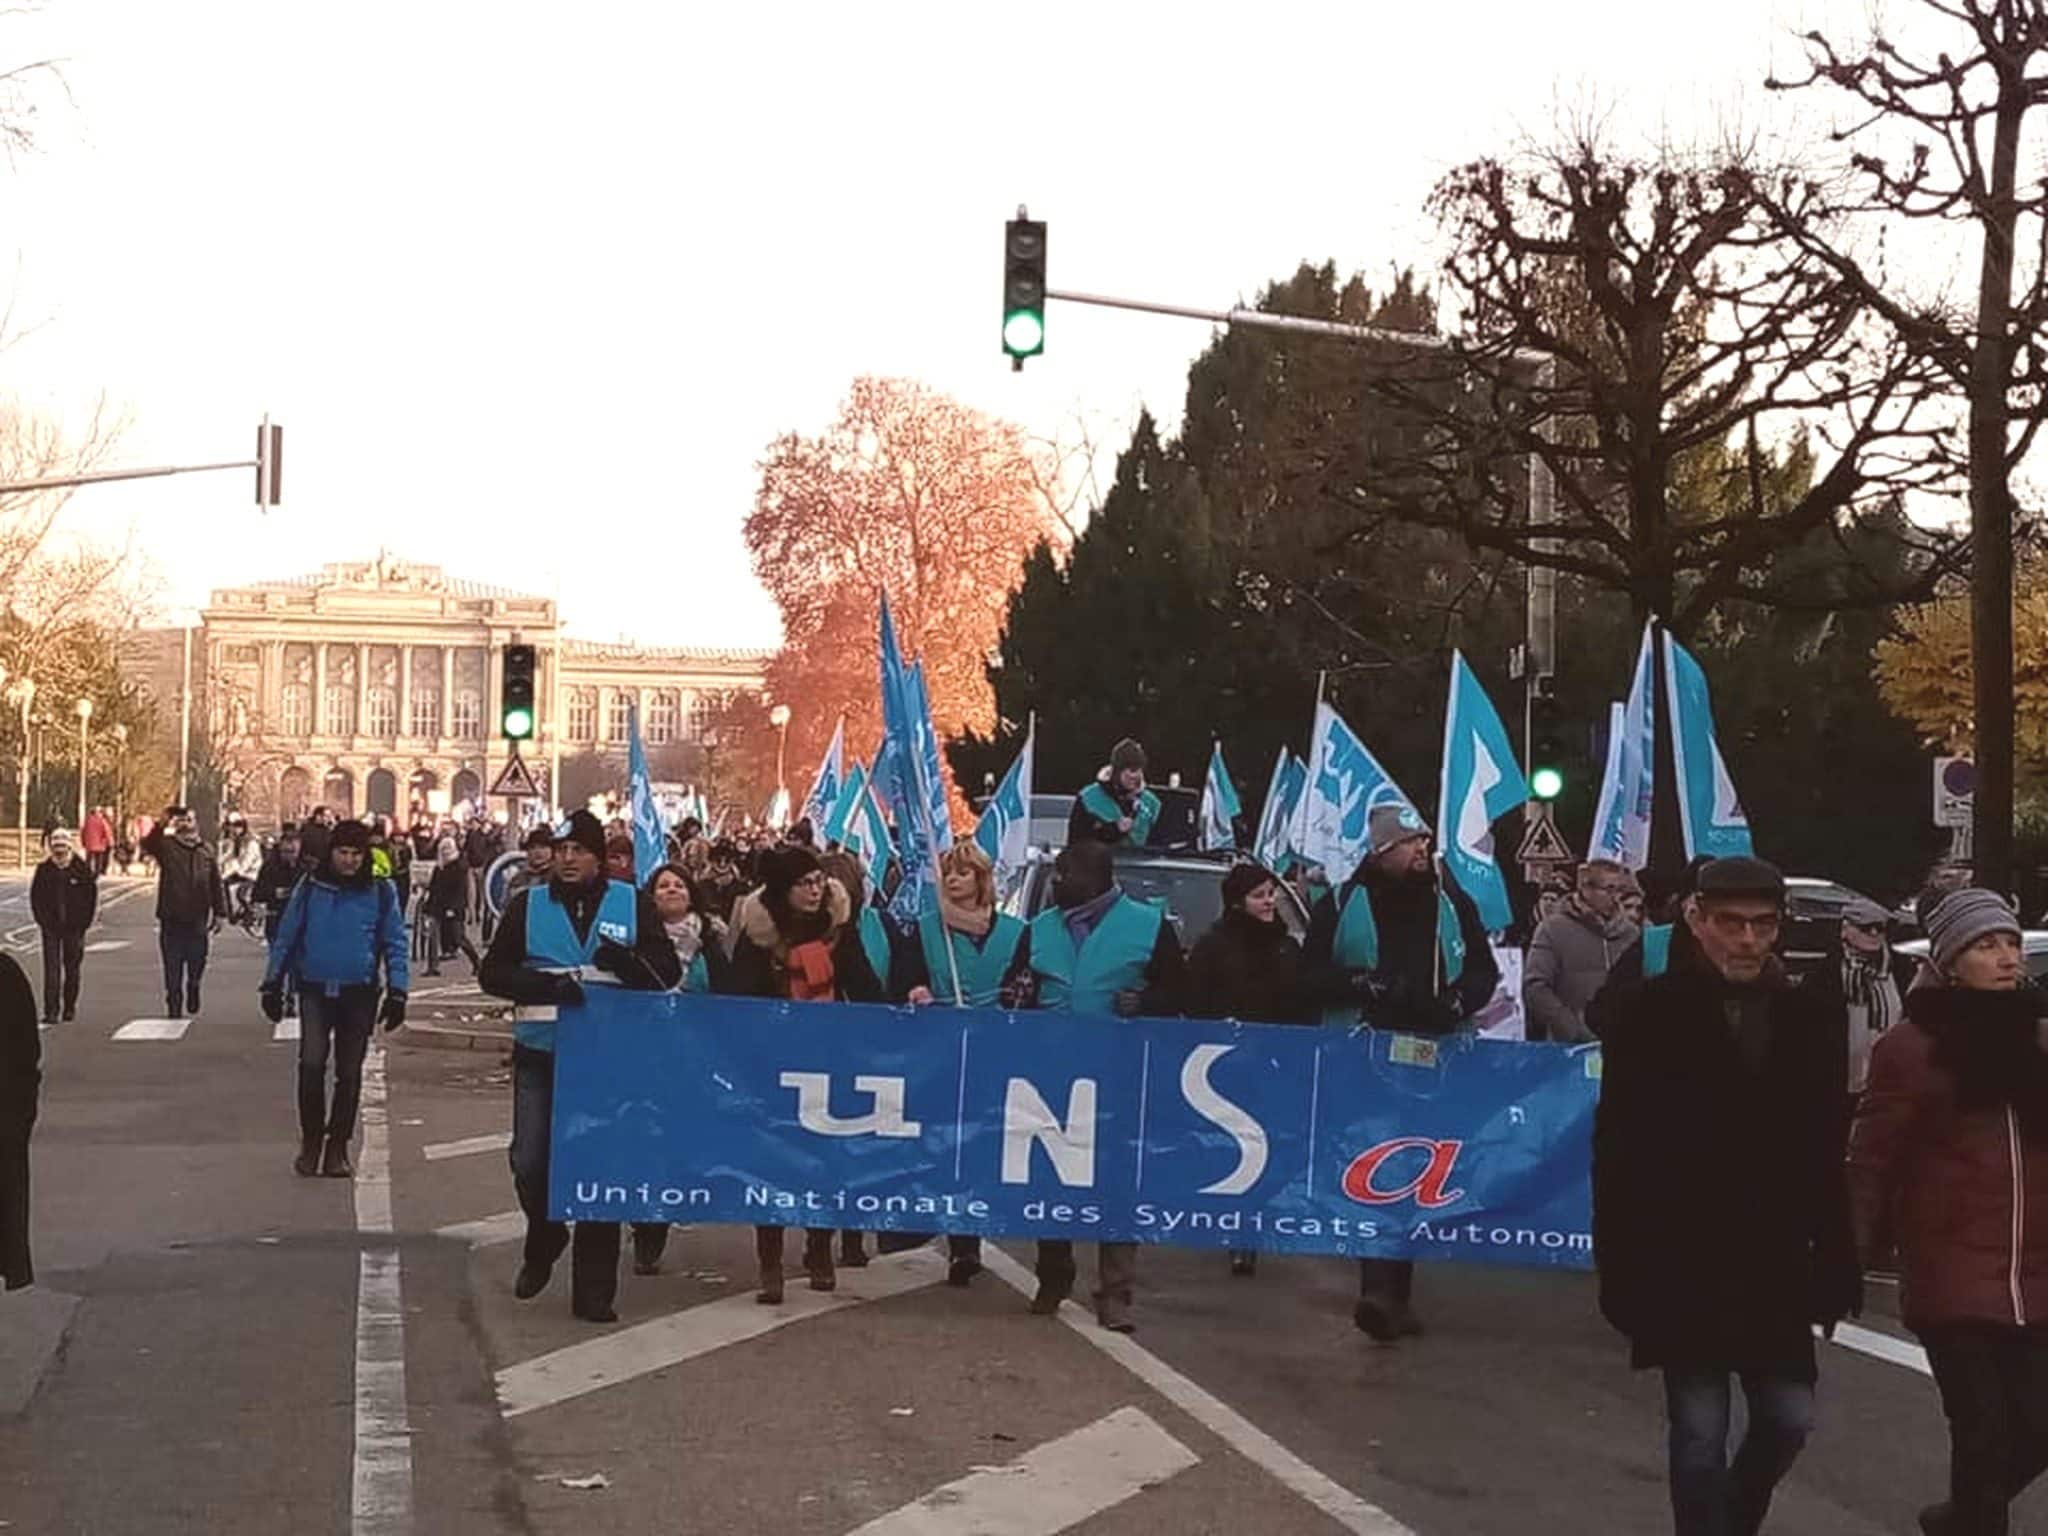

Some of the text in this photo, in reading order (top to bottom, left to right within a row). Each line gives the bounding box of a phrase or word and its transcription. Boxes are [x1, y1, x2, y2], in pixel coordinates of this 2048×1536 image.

[576, 1182, 710, 1204] Union
[745, 1186, 990, 1218] Nationale
[1023, 1199, 1101, 1223] des
[1135, 1204, 1378, 1238] Syndicats
